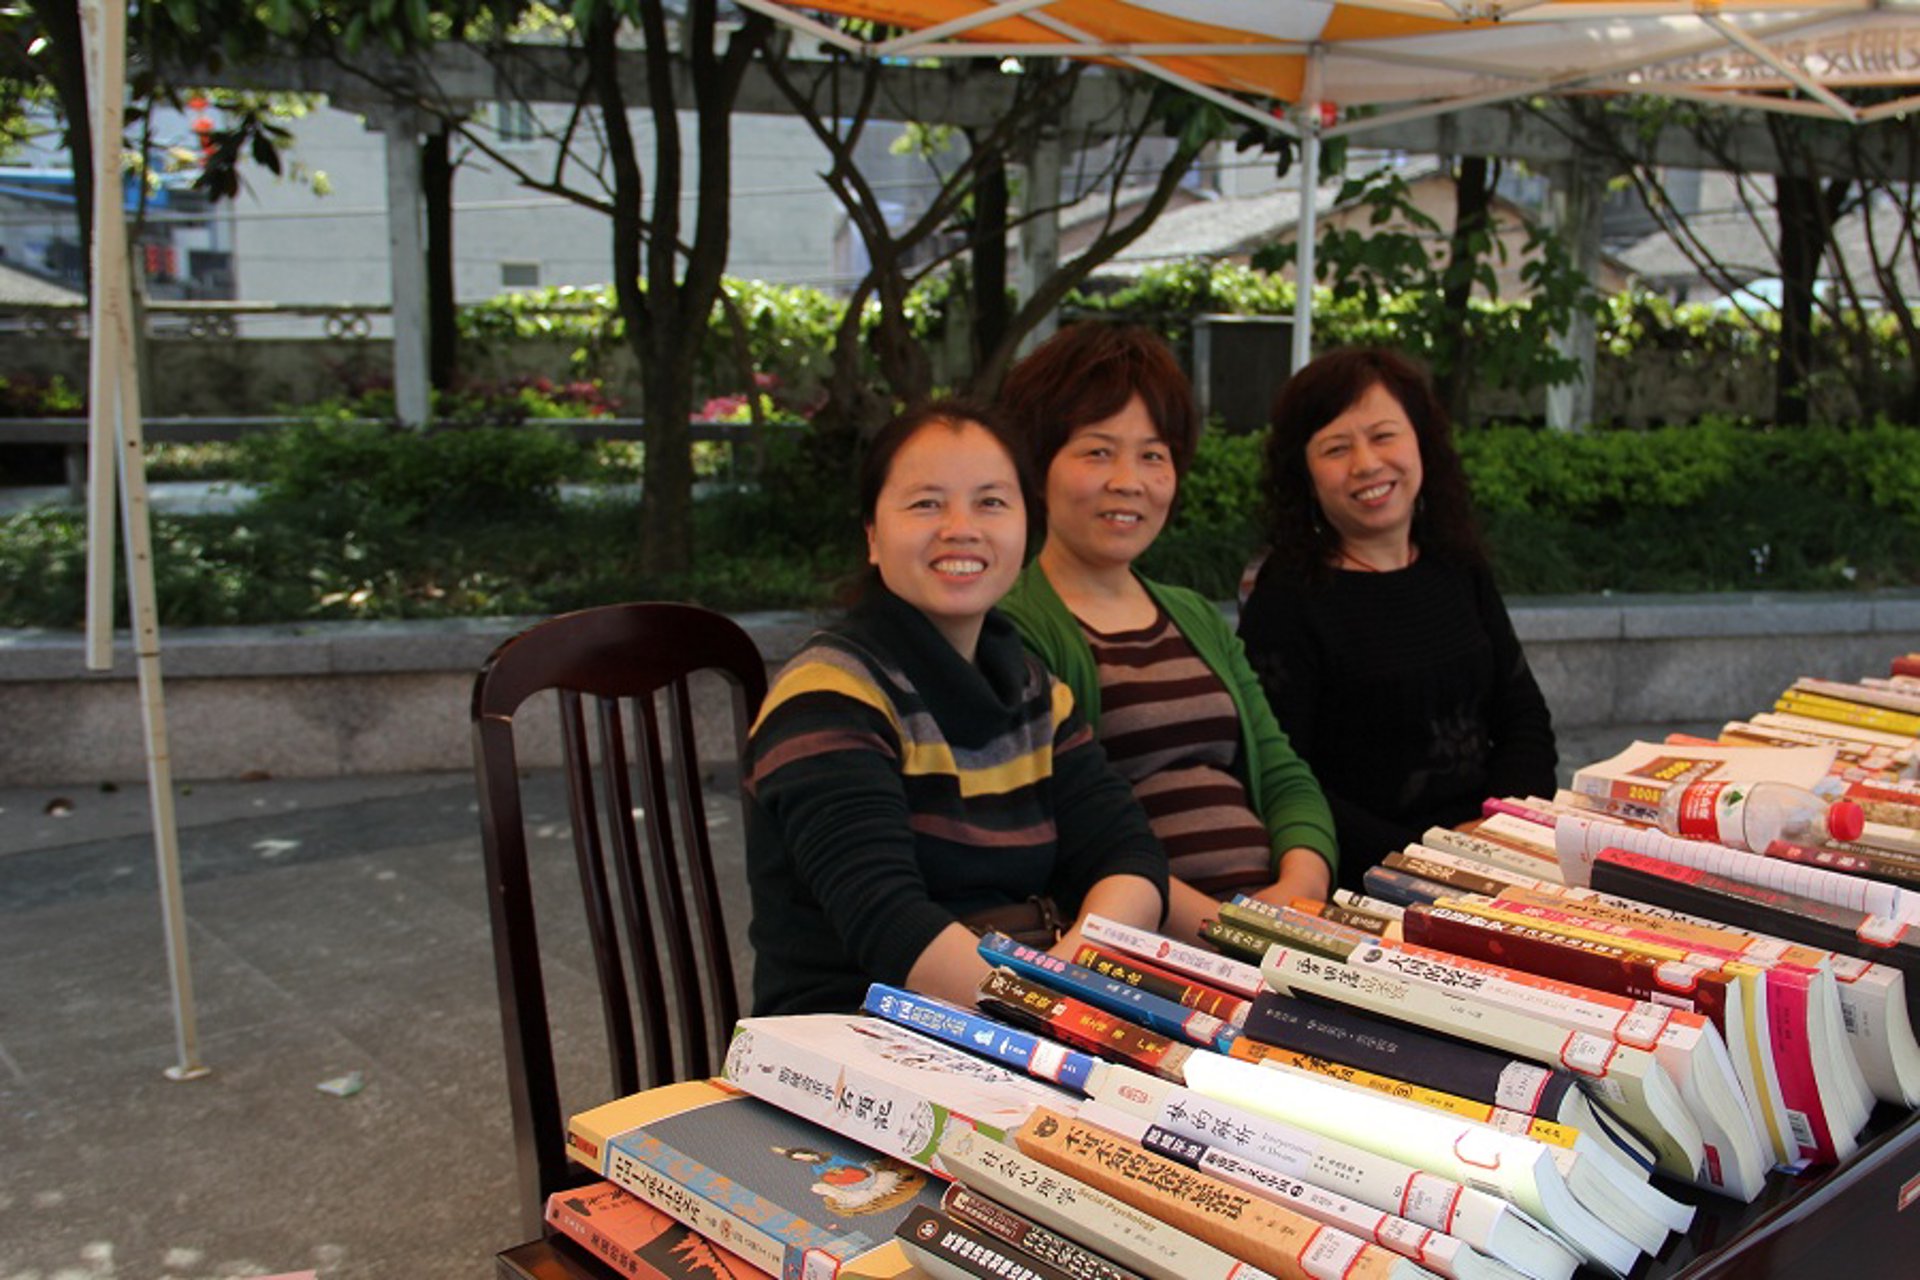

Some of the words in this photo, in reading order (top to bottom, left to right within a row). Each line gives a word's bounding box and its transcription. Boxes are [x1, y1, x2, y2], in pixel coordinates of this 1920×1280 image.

[1629, 785, 1661, 803] 2008
[1166, 1100, 1255, 1147] 梦的解析
[979, 1149, 1077, 1206] 社会心理学
[1077, 1186, 1106, 1208] Social
[1105, 1200, 1158, 1232] Psychology
